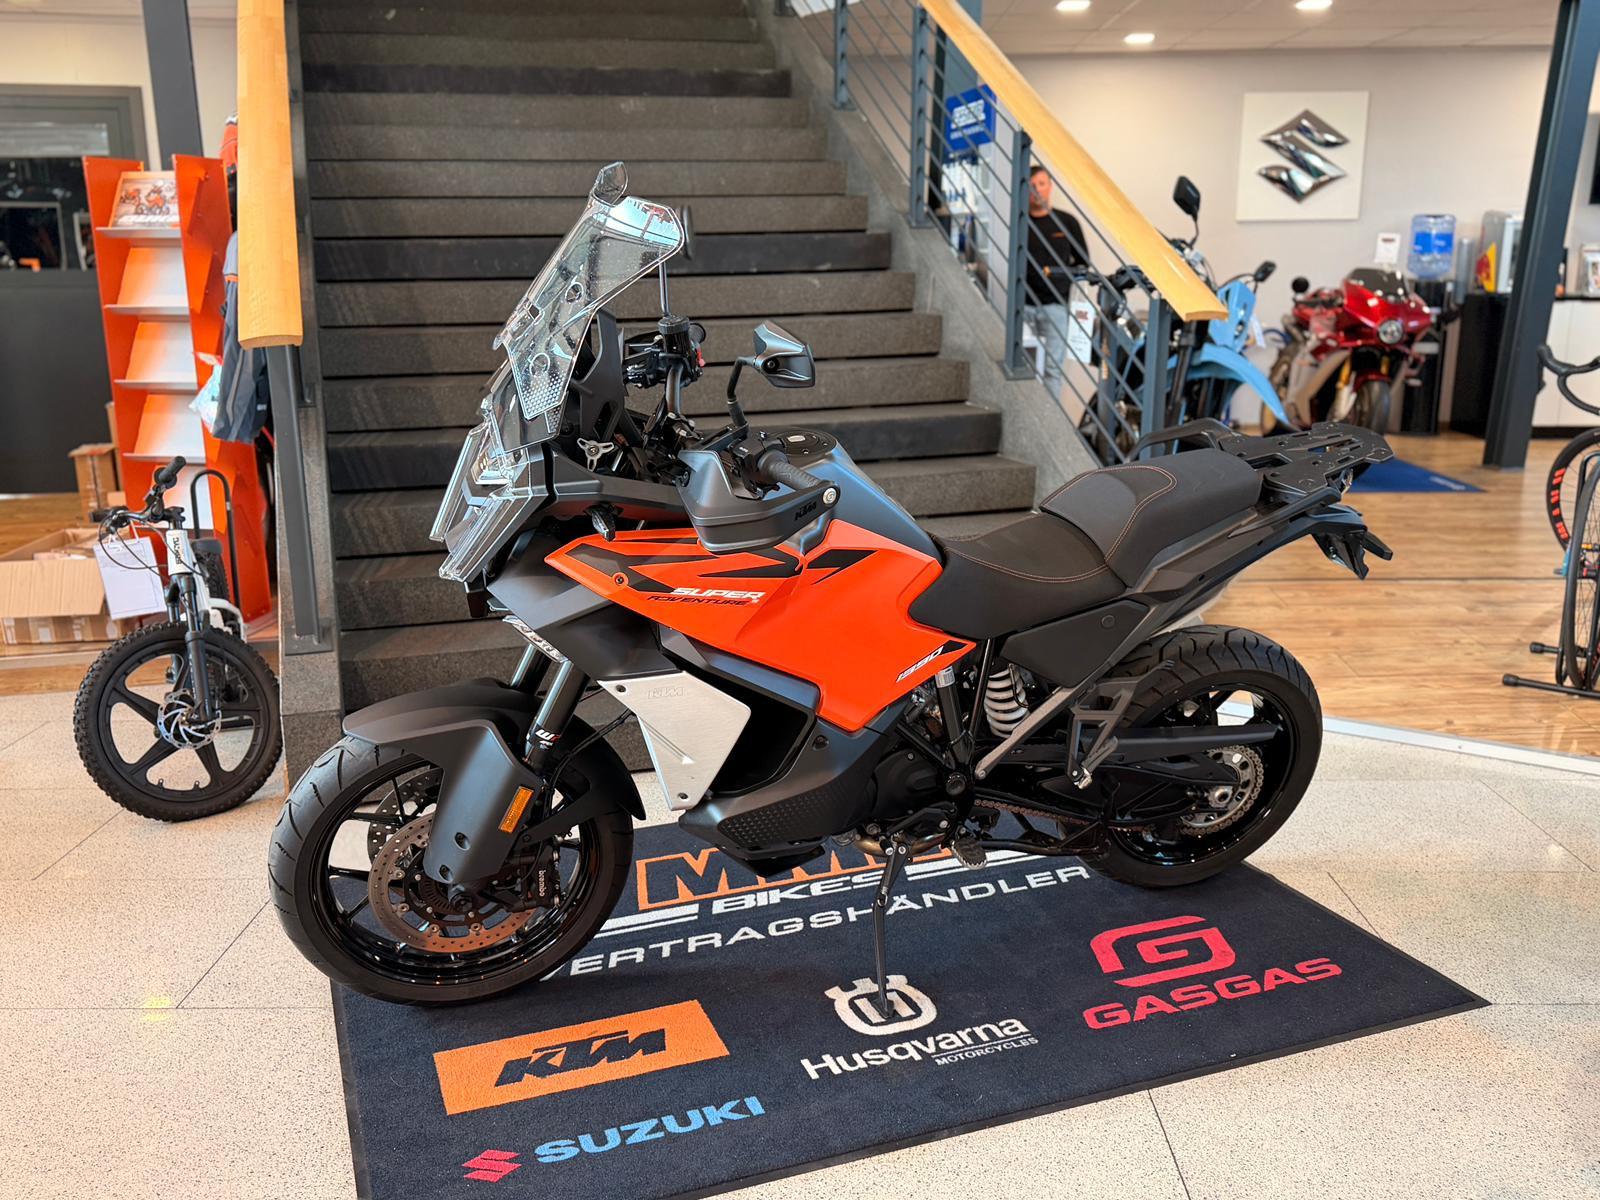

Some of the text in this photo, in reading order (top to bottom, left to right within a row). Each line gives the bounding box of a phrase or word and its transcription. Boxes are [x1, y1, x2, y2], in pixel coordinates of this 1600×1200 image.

[647, 595, 751, 606] ADVENTURE
[670, 587, 767, 600] SUPER
[537, 869, 547, 897] brembo
[711, 868, 886, 915] BIKES
[542, 866, 1091, 982] ERTRAGSHÄNDLER
[1083, 957, 1343, 1030] GASGAS
[494, 1027, 667, 1088] KTM
[800, 1018, 1030, 1081] Husqvarna
[934, 1037, 1039, 1066] MOTORCYCLES
[534, 1096, 766, 1164] SUZUKI
